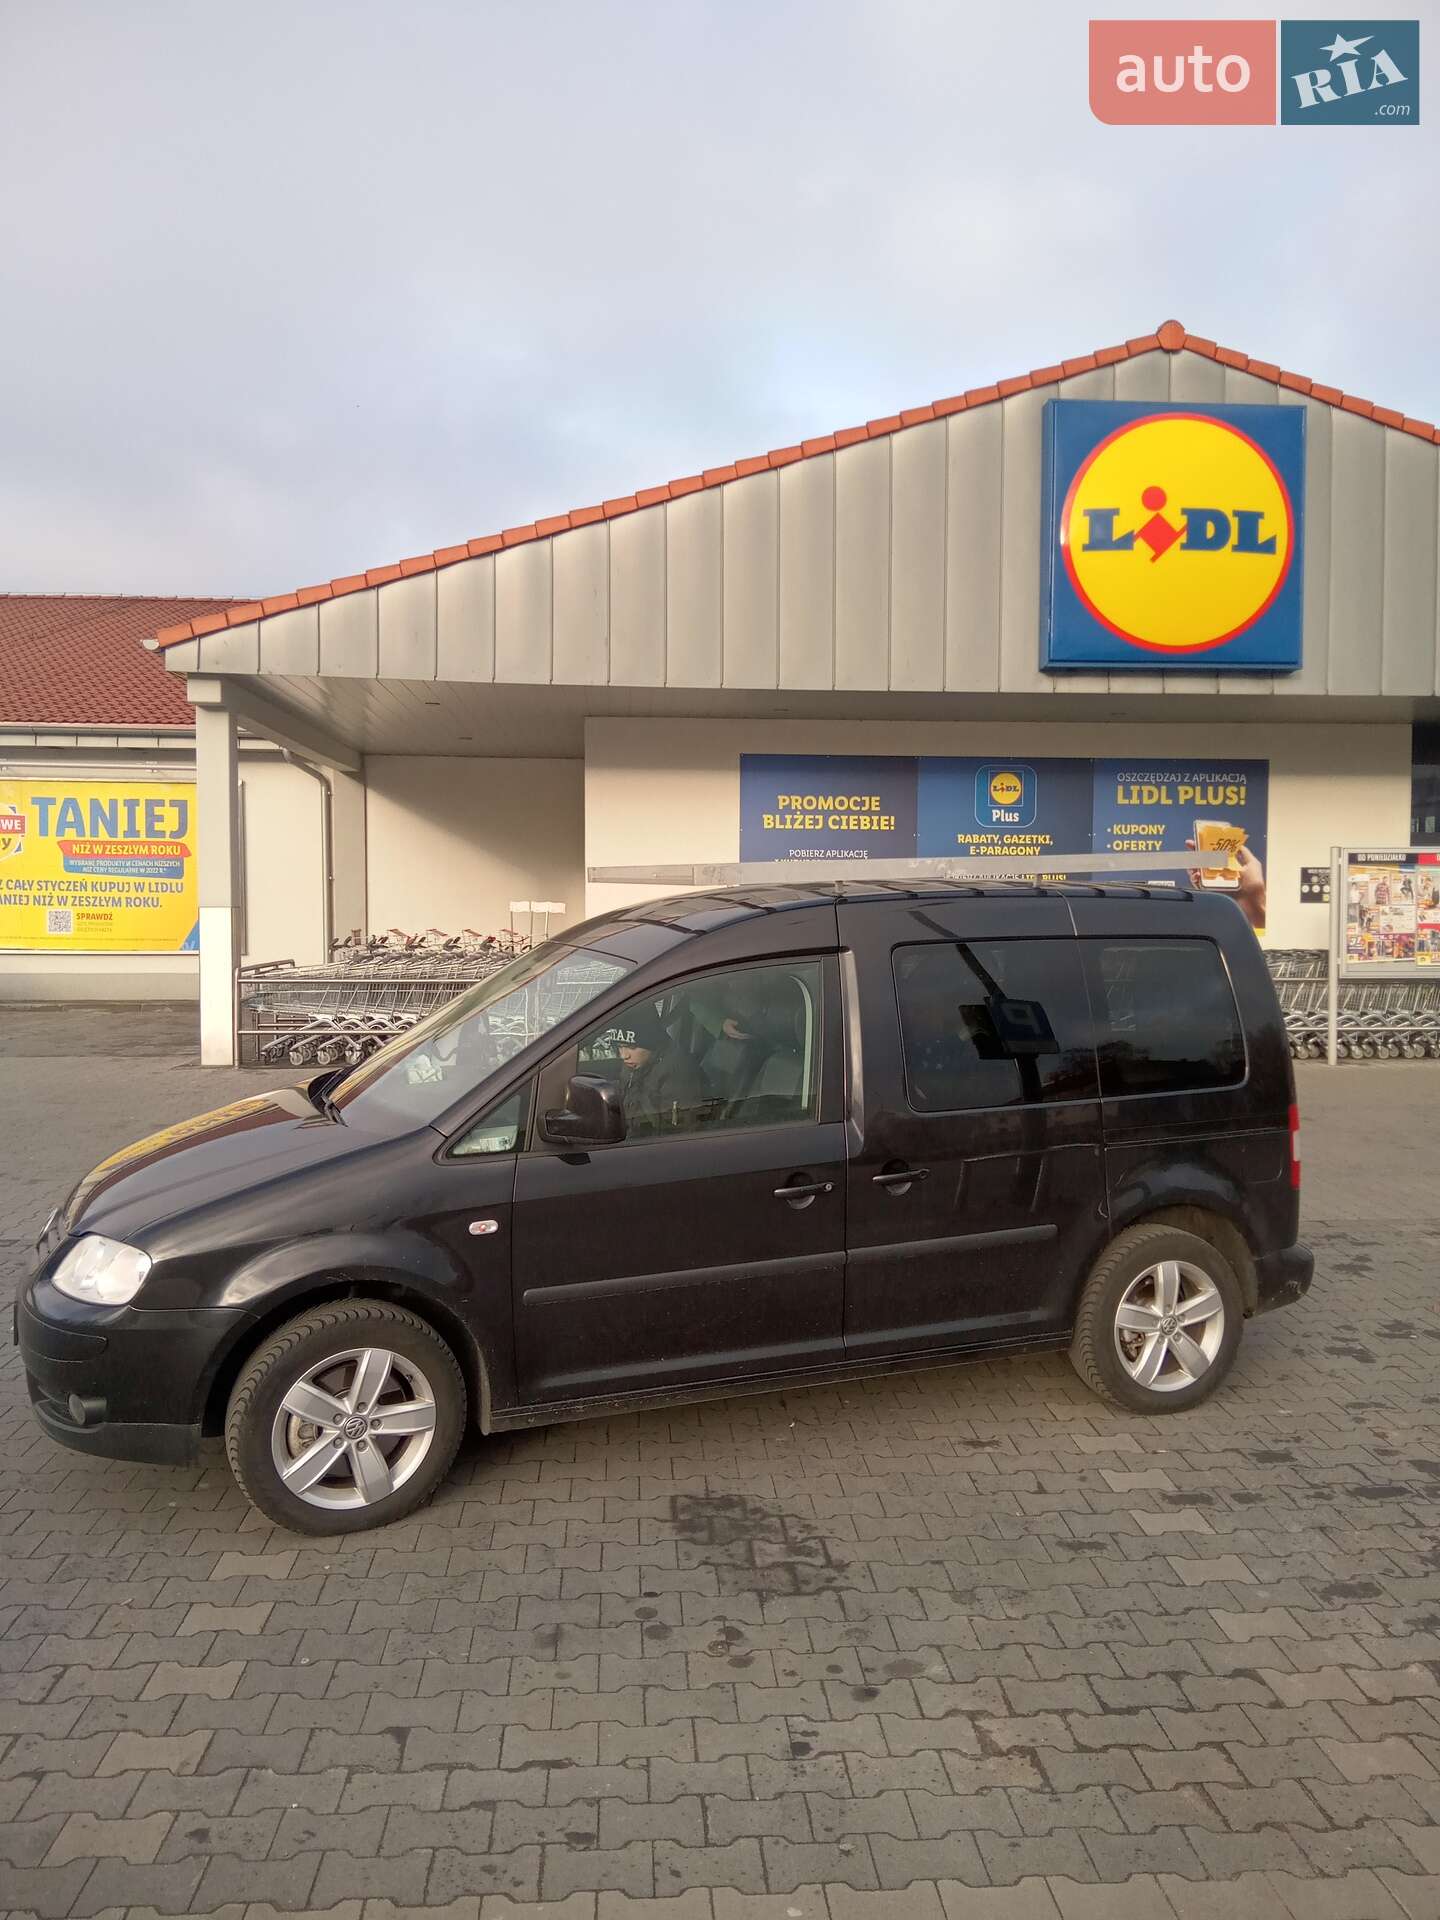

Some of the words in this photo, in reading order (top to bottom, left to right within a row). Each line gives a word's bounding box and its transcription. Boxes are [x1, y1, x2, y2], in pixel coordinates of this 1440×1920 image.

[1082, 486, 1277, 563] LIDL
[1117, 773, 1181, 785] OSZCZĘDZAJ
[1184, 773, 1192, 783] Z
[993, 782, 1019, 793] LIDL
[1117, 785, 1173, 805] LIDL
[1178, 786, 1246, 806] PLUS!
[777, 795, 880, 811] PROMOCJE
[31, 797, 188, 839] TANIEJ
[763, 811, 823, 829] BLIŻEJ
[828, 815, 895, 830] CIEBIE!
[992, 809, 1019, 822] Plus
[1113, 824, 1165, 835] KUPONY
[957, 834, 1002, 845] RABATY,
[1003, 834, 1053, 846] GAZETKI,
[1113, 841, 1162, 851] OFERTY
[72, 842, 91, 854] NIŻ
[93, 845, 104, 855] W
[151, 845, 181, 856] ROKU
[789, 849, 824, 858] POBIERZ
[969, 846, 1041, 856] E-PARAGONY
[6, 880, 34, 891] CAŁY
[91, 881, 130, 893] KUPUJ
[134, 882, 145, 893] W
[148, 882, 184, 893] LIDLU
[33, 892, 54, 906] NIŻ
[57, 895, 68, 906] W
[125, 897, 163, 908] ROKU.
